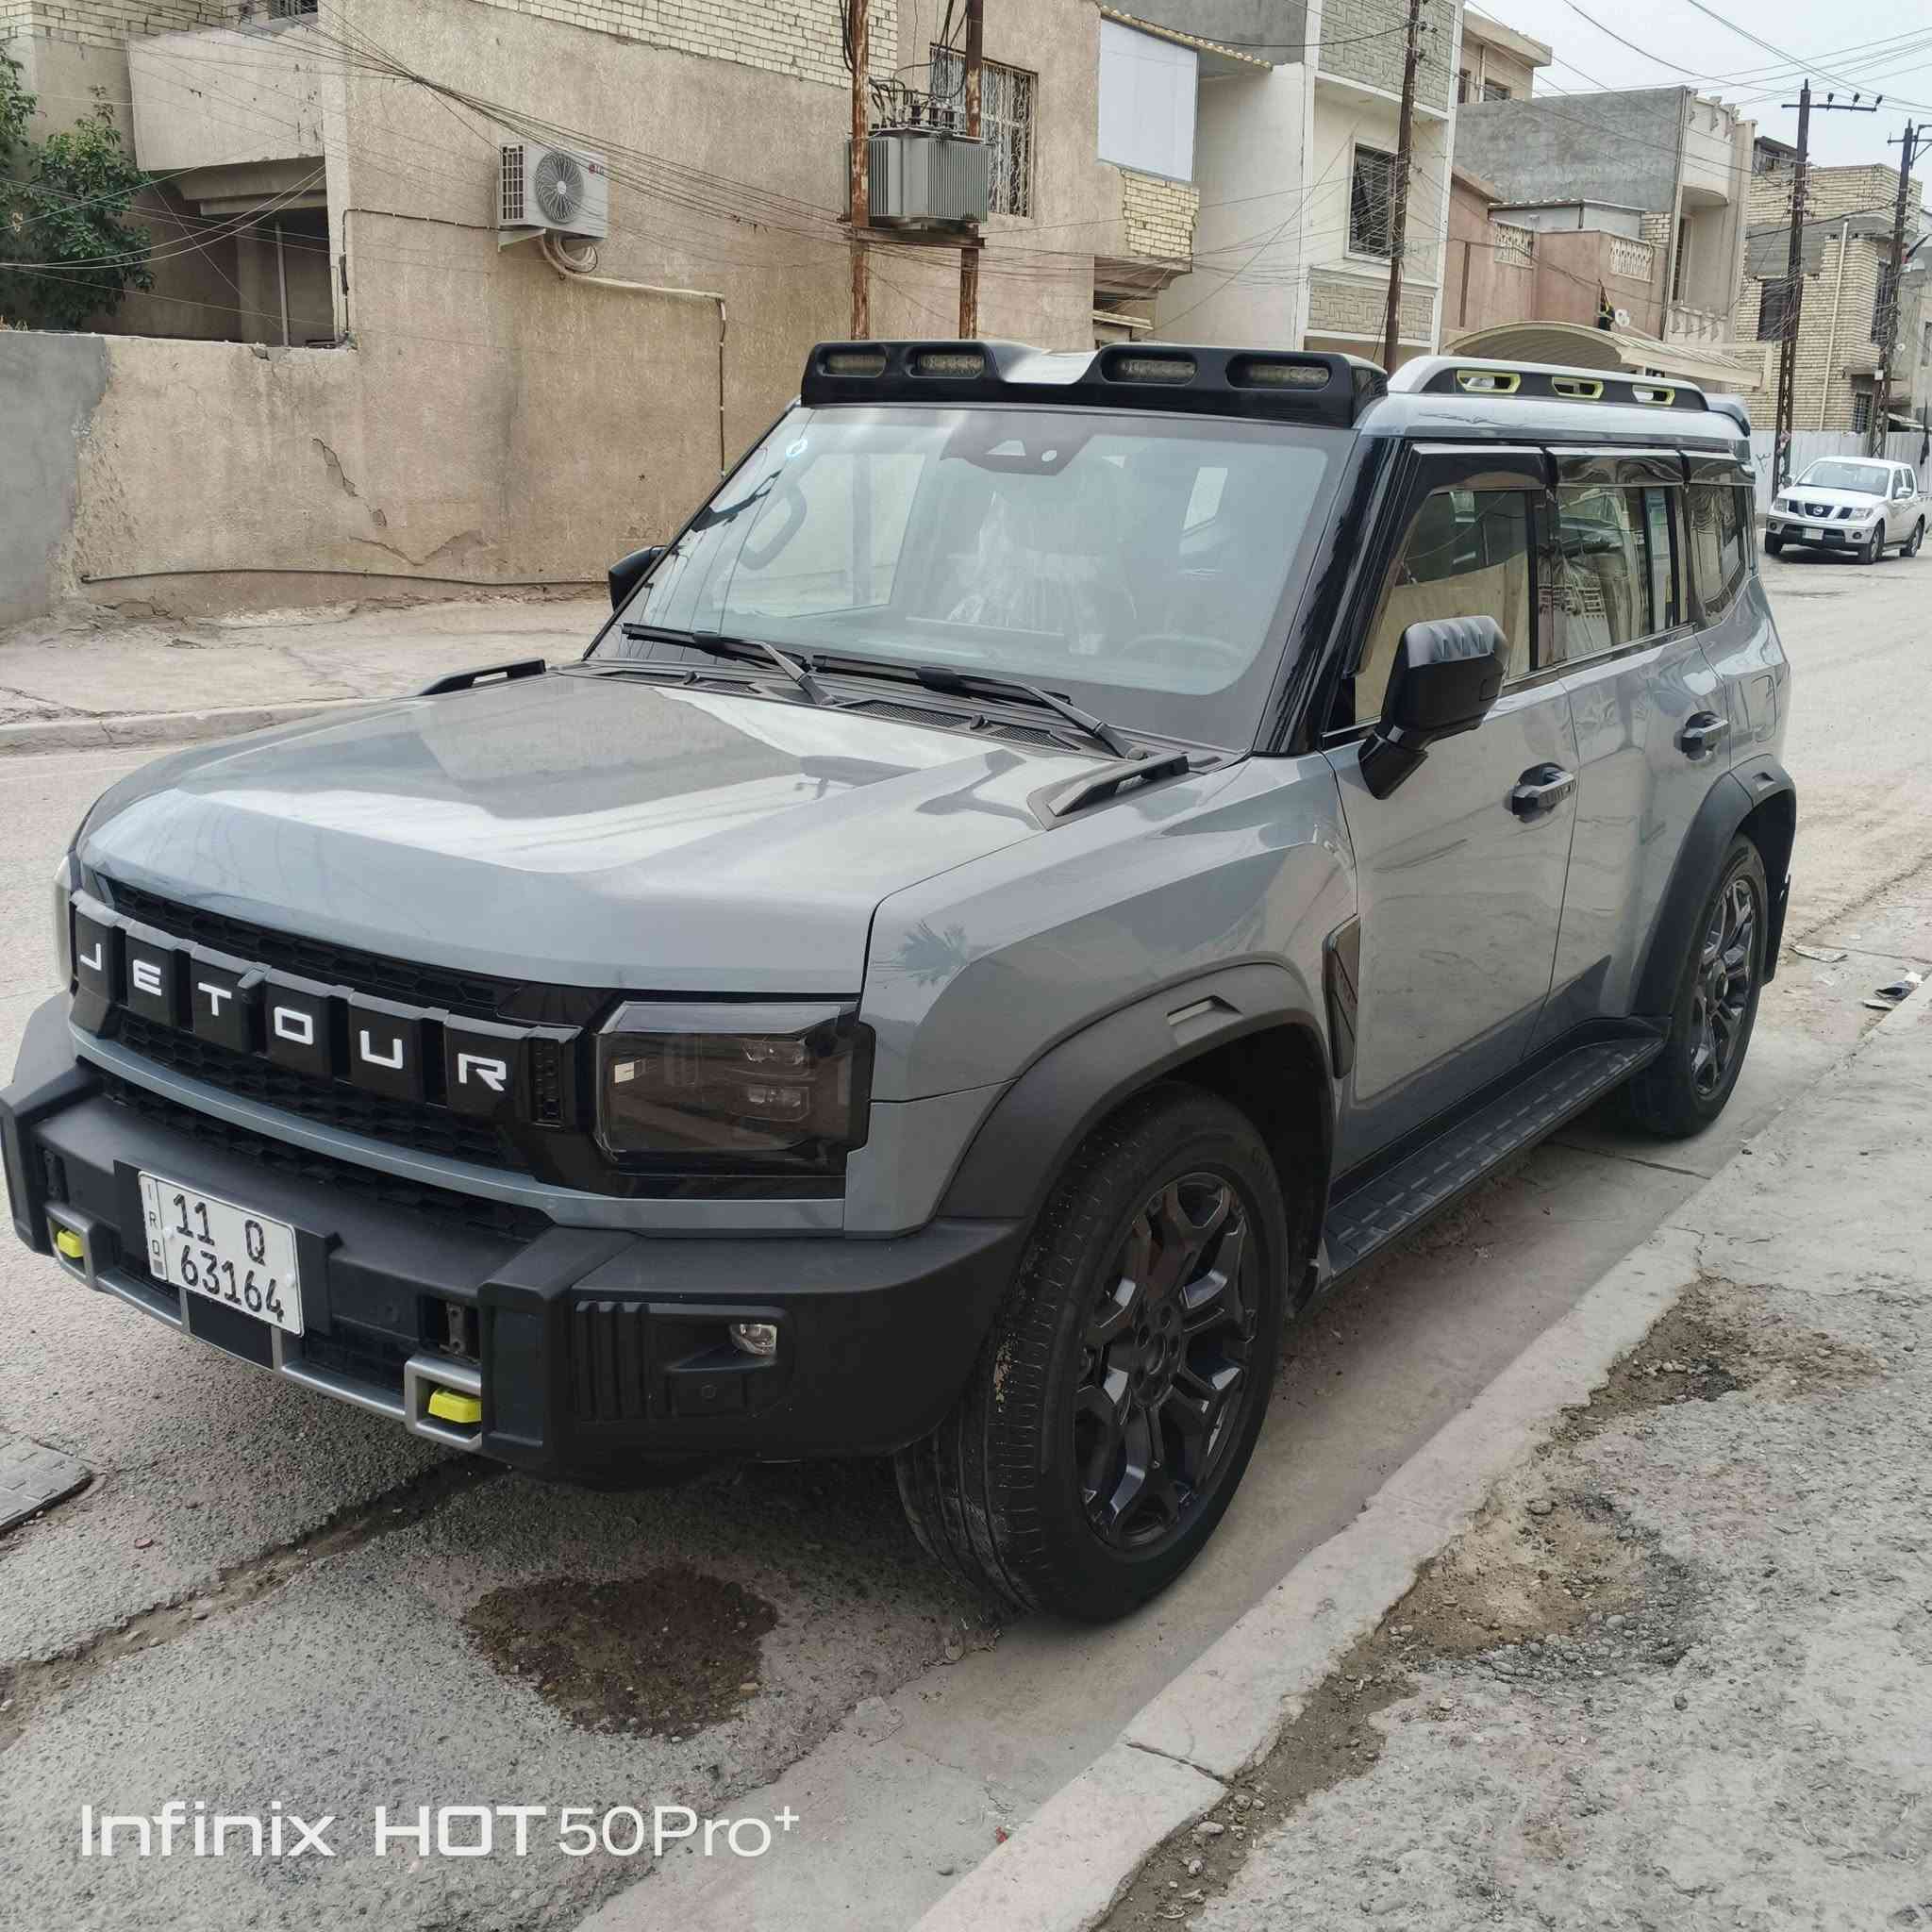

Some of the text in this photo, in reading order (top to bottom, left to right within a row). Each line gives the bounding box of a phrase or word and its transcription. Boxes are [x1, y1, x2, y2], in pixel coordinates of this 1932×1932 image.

[79, 942, 507, 1092] JETOUR
[173, 1193, 266, 1267] 11 Q
[180, 1244, 285, 1323] 63164
